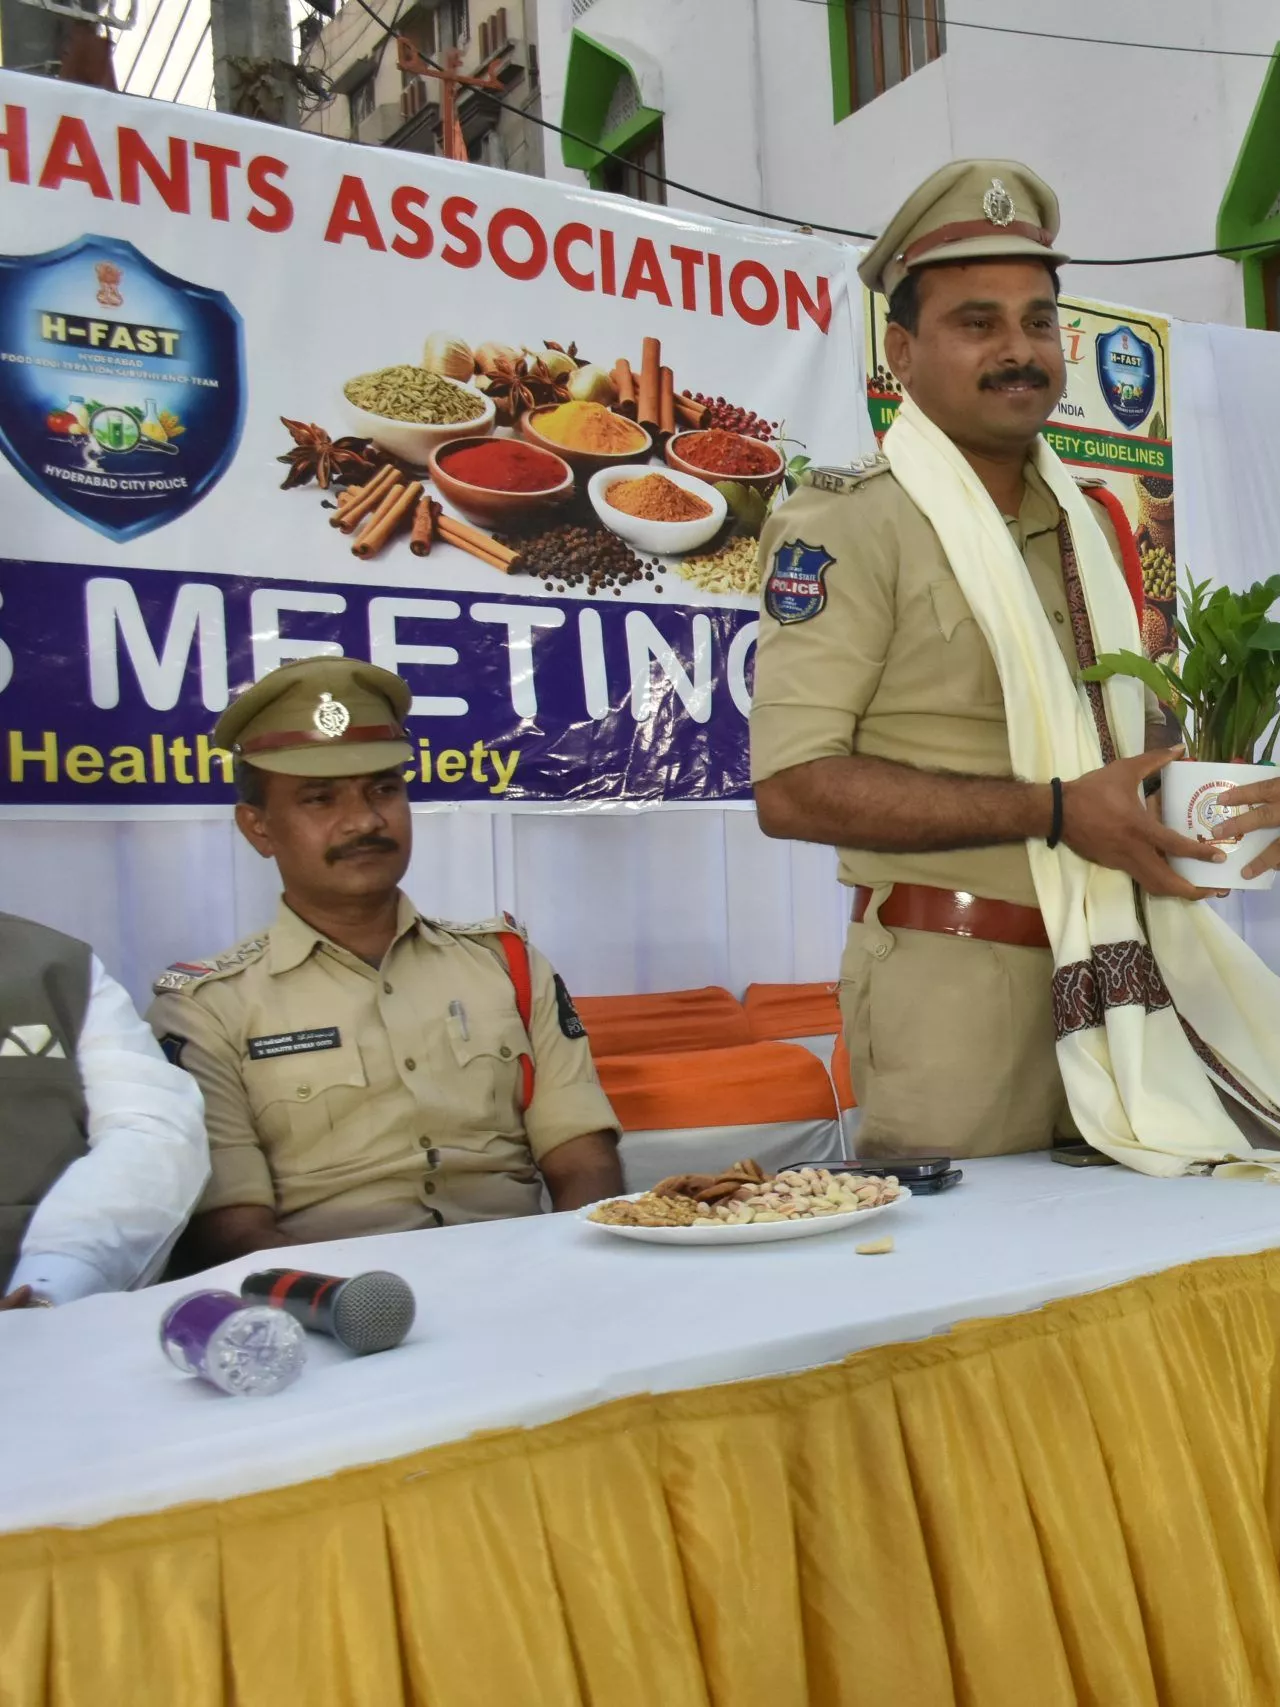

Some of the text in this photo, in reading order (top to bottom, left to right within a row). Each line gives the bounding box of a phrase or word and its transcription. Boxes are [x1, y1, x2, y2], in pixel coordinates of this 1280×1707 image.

[323, 173, 833, 335] ASSOCIATION
[41, 313, 180, 356] H-FAST
[1, 352, 32, 364] FOOD
[190, 376, 219, 388] TEAM
[78, 352, 144, 368] HYDERABAD
[1111, 352, 1142, 367] H-FAST
[1057, 402, 1086, 419] INDIA
[1084, 440, 1164, 467] GUIDELINES
[44, 464, 189, 491] HYDERABAD CITY POLICE
[771, 578, 820, 595] POLICE
[9, 730, 236, 785] Health
